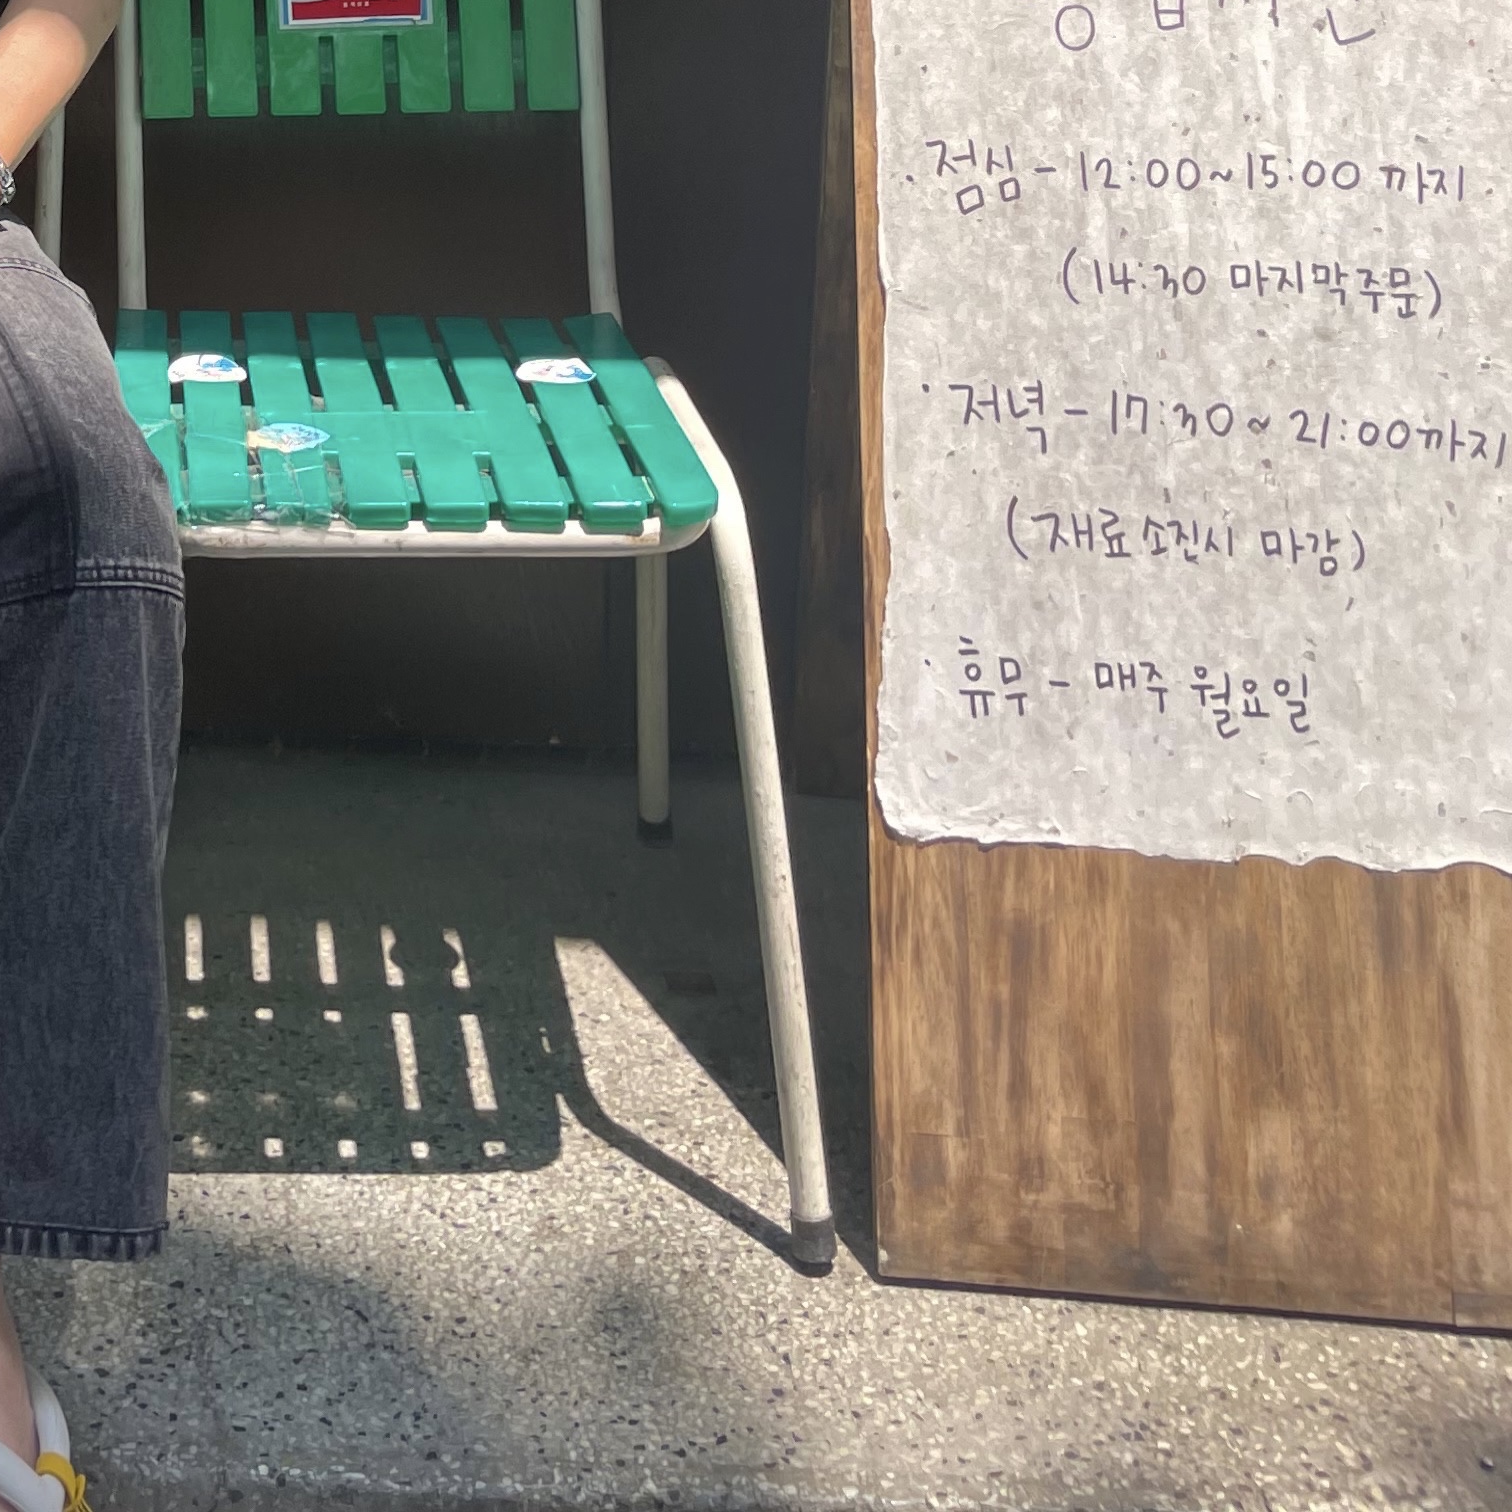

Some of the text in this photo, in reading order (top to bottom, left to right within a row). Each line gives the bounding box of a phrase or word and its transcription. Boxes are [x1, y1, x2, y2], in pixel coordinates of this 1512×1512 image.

[1379, 162, 1465, 205] 까지
[1261, 528, 1366, 577] 마감)
[1093, 660, 1169, 714] 매주
[1189, 664, 1313, 739] 월요일
